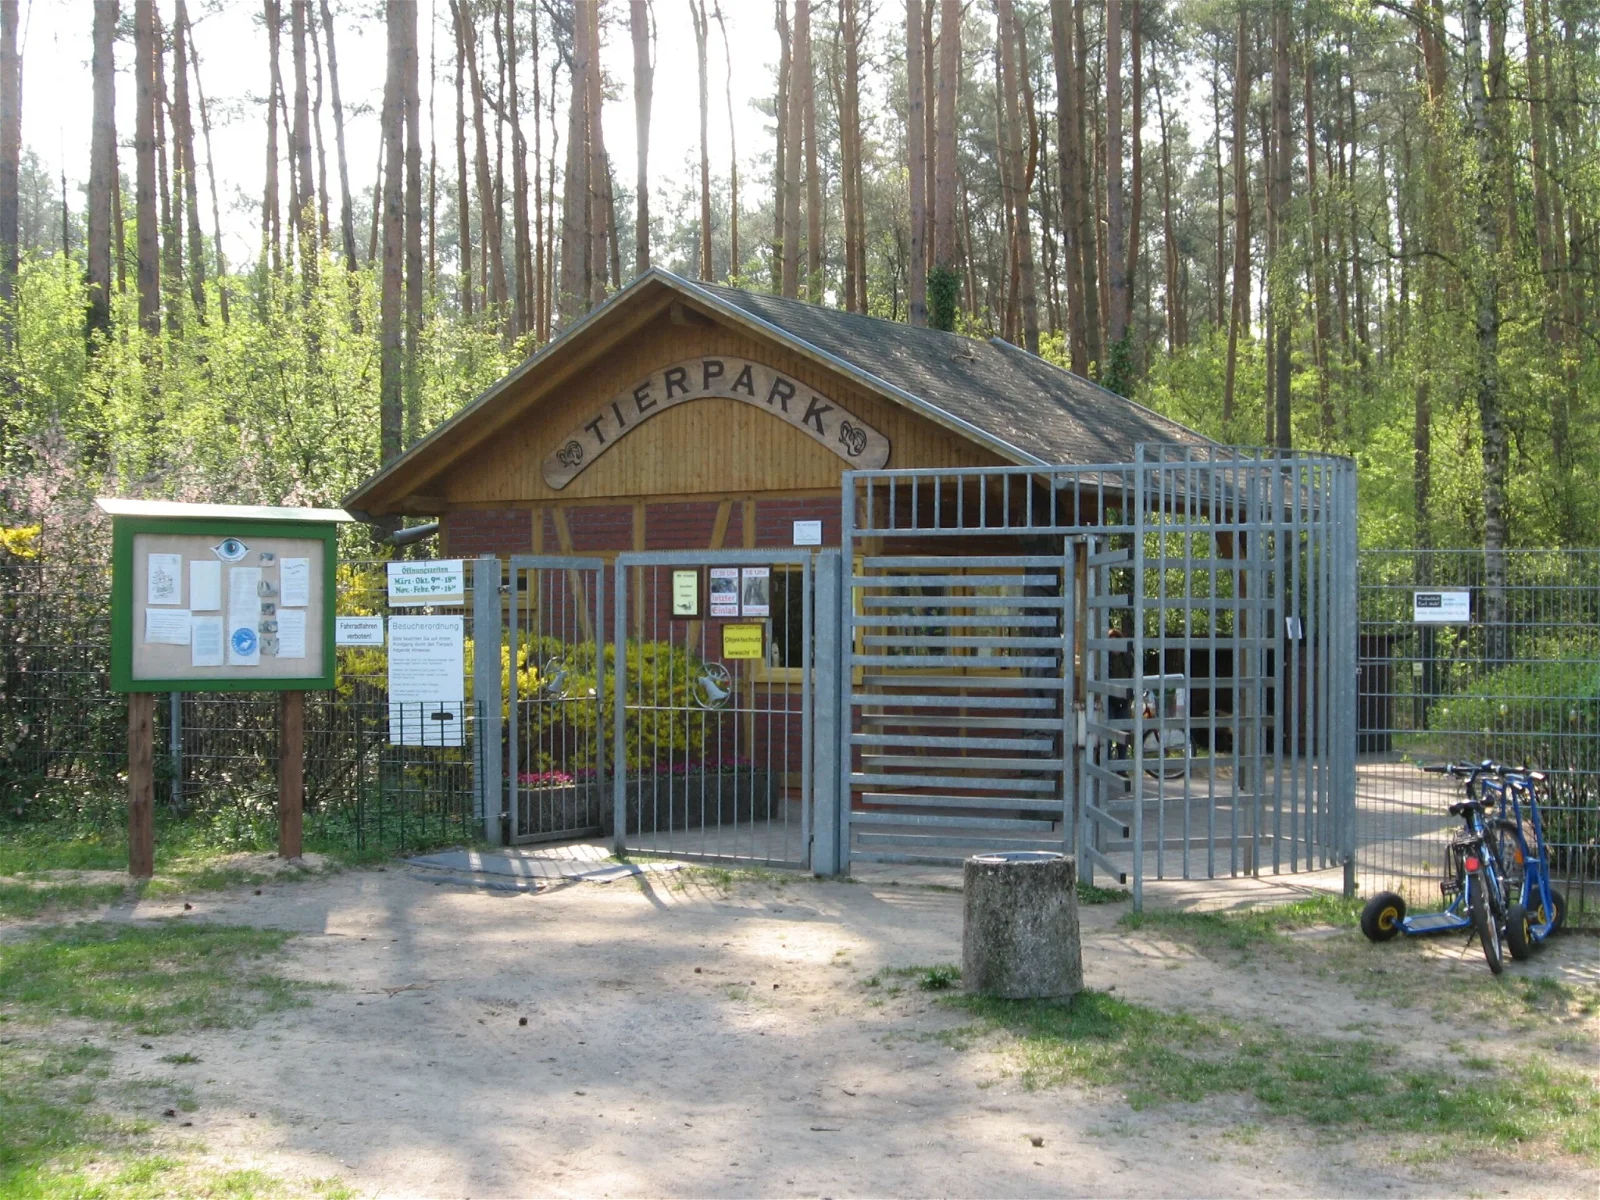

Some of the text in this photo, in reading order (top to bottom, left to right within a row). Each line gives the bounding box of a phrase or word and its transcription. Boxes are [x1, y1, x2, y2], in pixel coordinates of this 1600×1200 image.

[584, 359, 836, 446] TIERPARK
[401, 566, 449, 574] Öffnungszeiten
[394, 577, 411, 585] März
[392, 622, 460, 631] Besucherordnung
